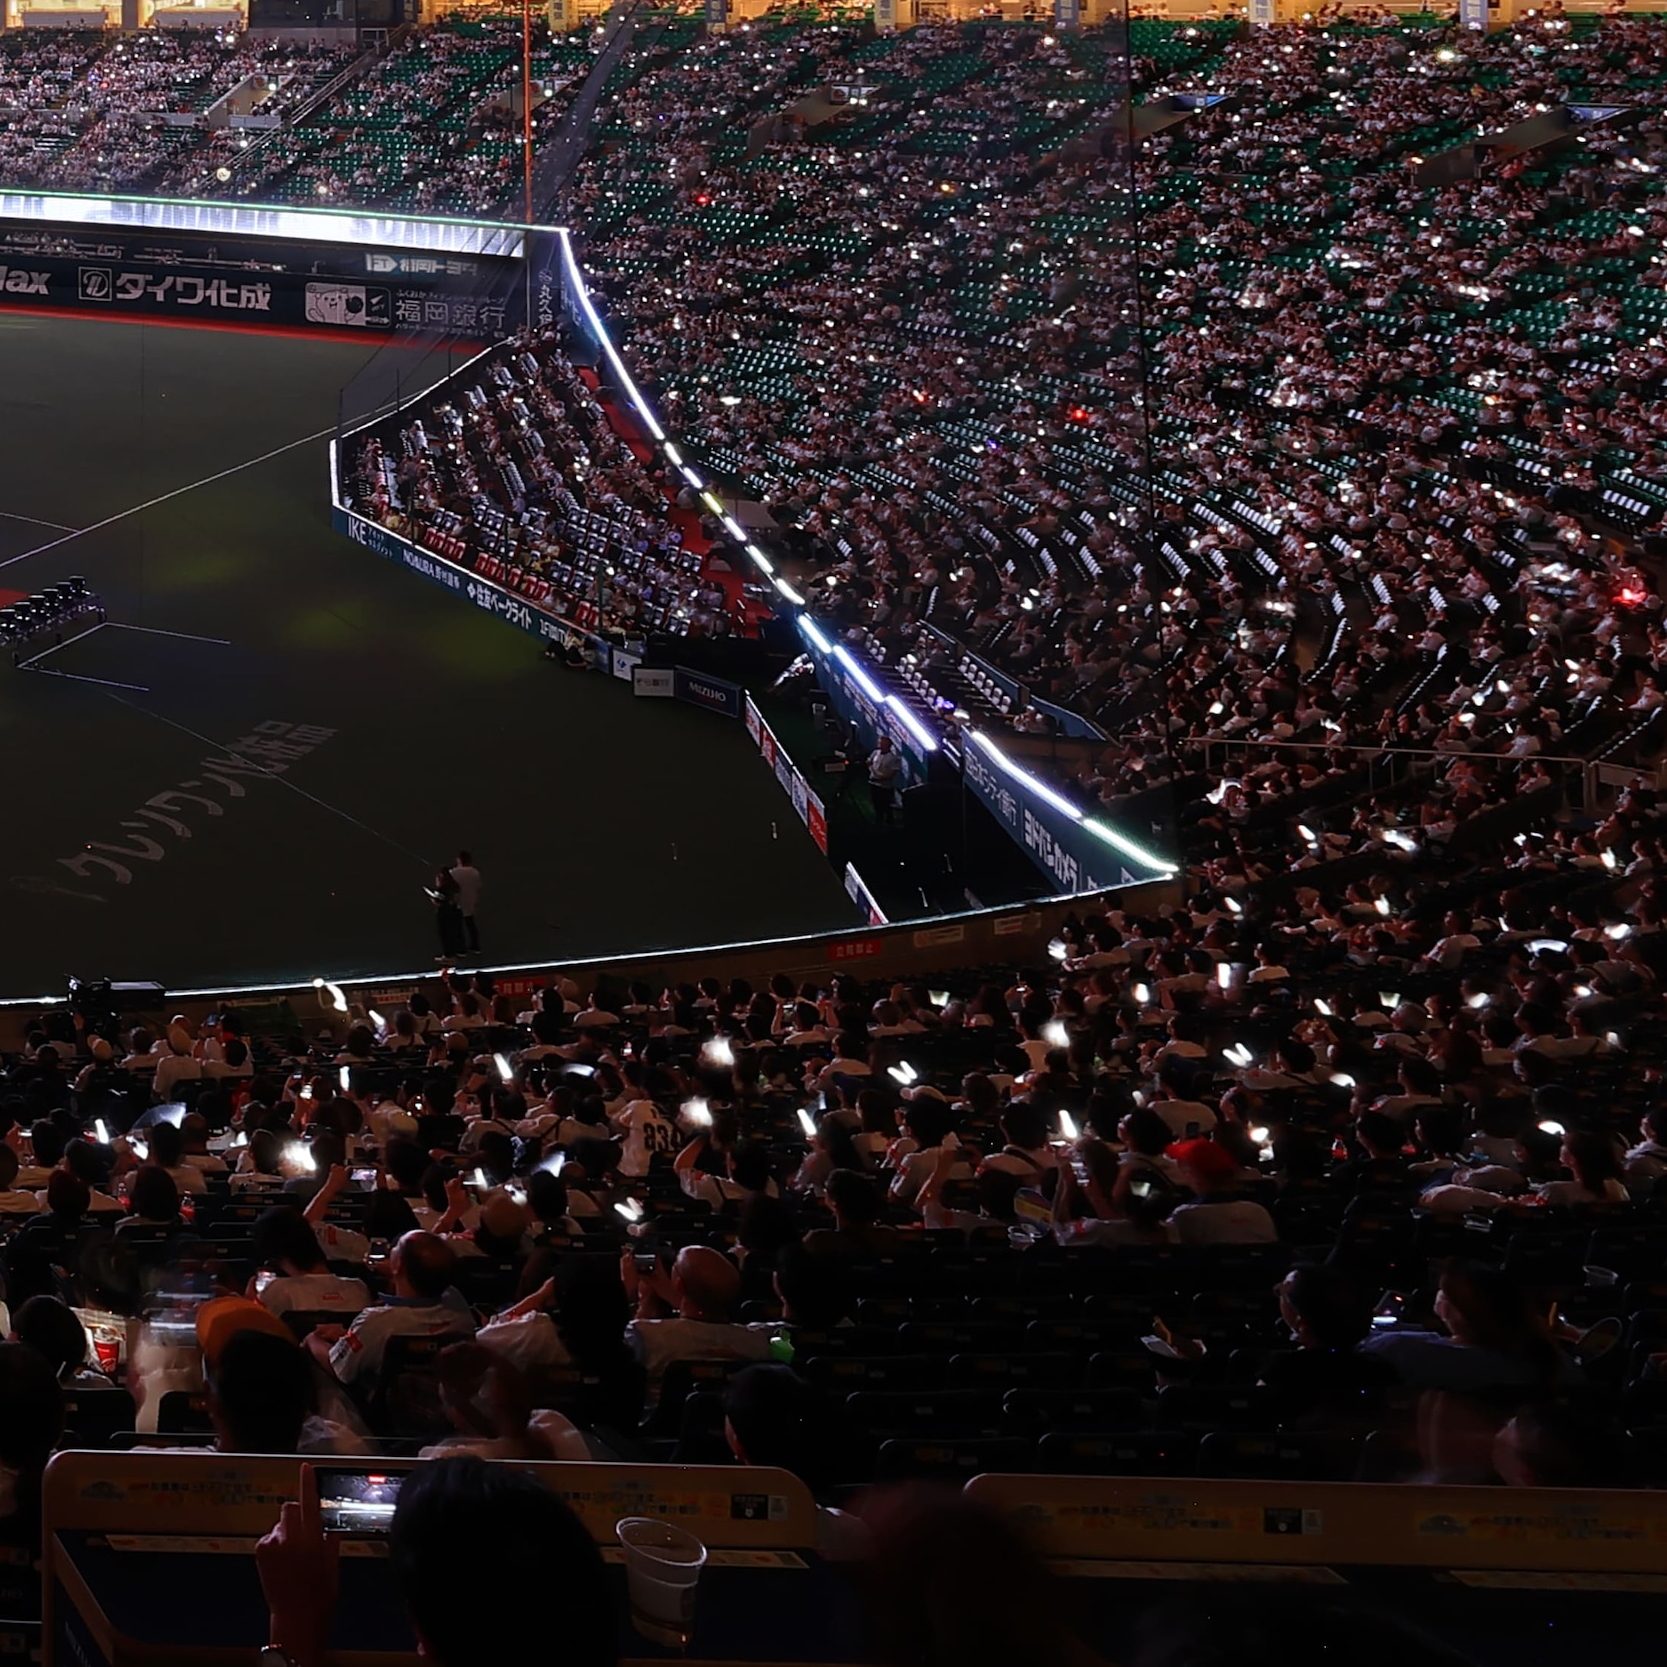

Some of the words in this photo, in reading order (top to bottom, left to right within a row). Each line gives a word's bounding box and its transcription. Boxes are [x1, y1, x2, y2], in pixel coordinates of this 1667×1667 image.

[116, 273, 271, 311] ダイワ化成
[396, 299, 506, 329] 福岡銀行
[402, 549, 434, 578] NOMURA
